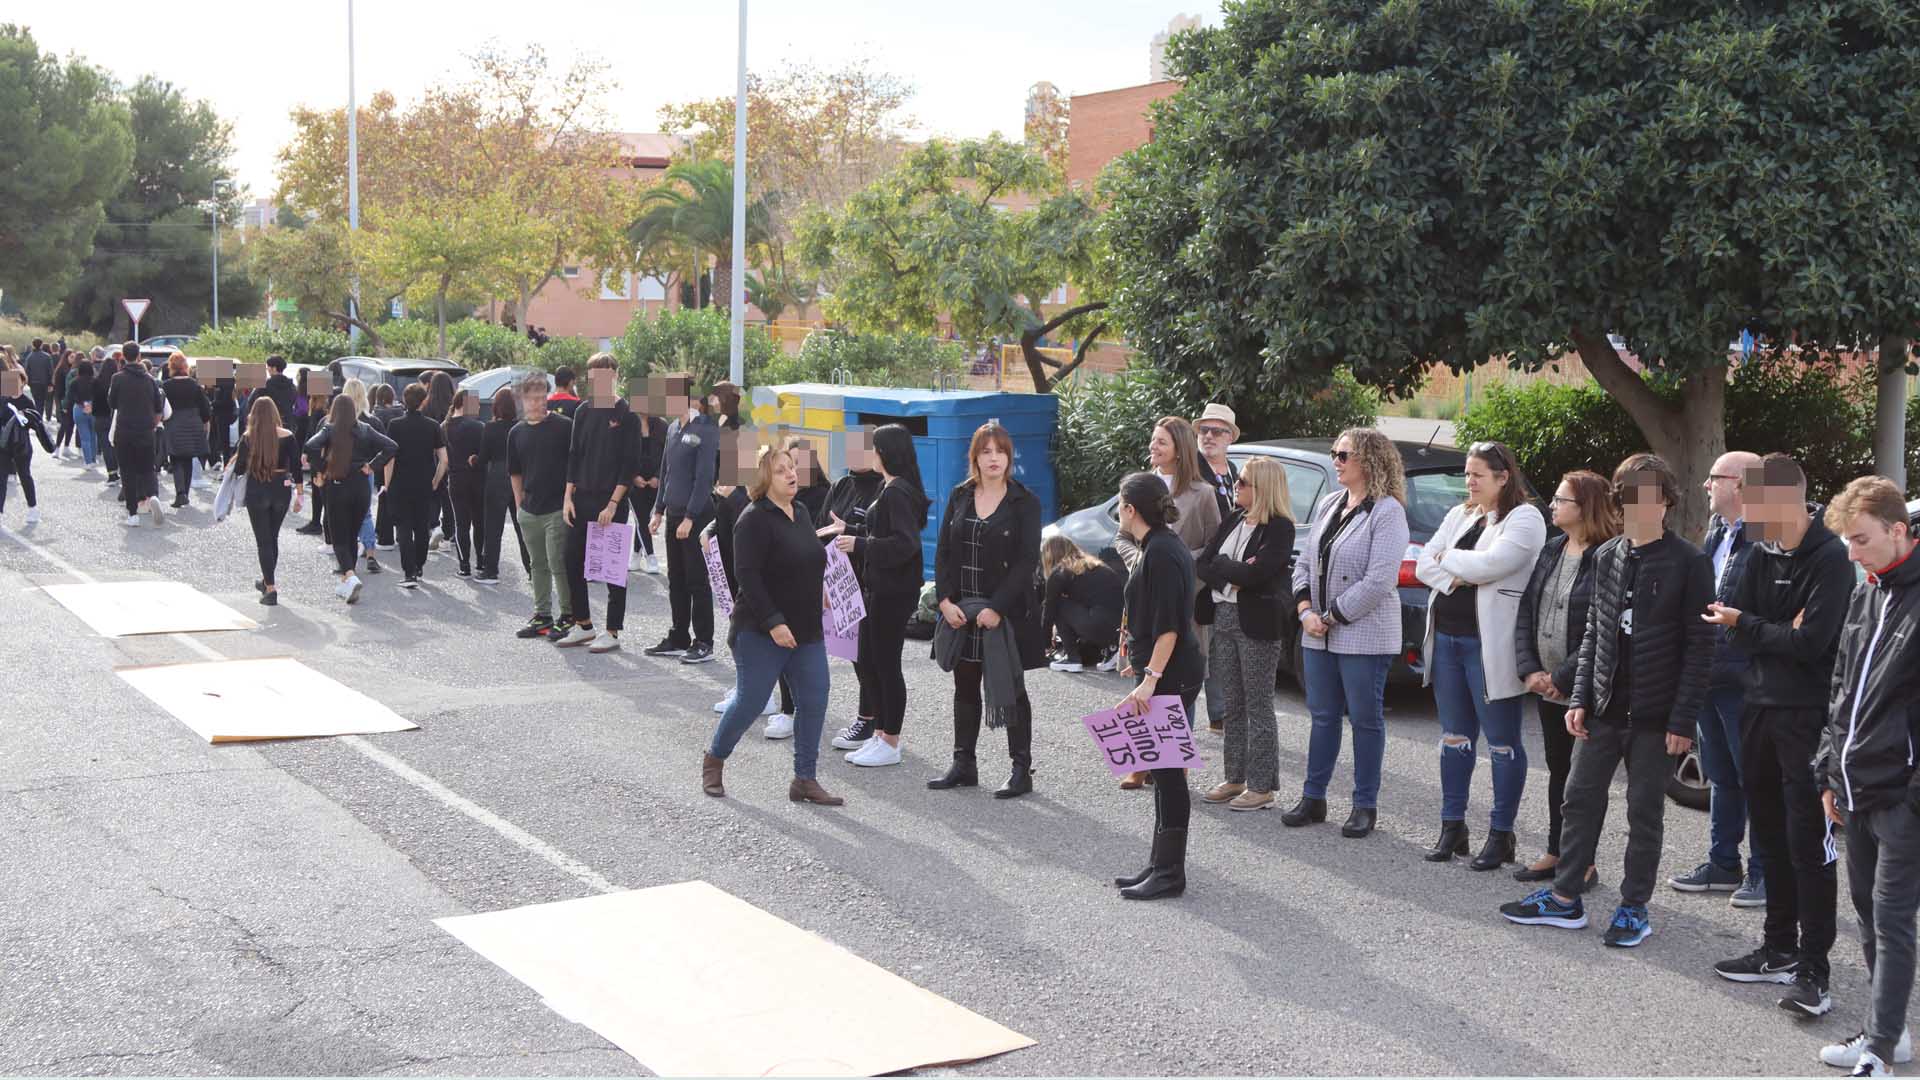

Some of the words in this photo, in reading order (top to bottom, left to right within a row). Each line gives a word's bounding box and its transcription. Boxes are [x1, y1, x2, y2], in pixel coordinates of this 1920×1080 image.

[1091, 718, 1122, 742] TE
[1154, 724, 1174, 743] TE
[1164, 703, 1195, 761] VALORA
[1107, 742, 1136, 766] SI
